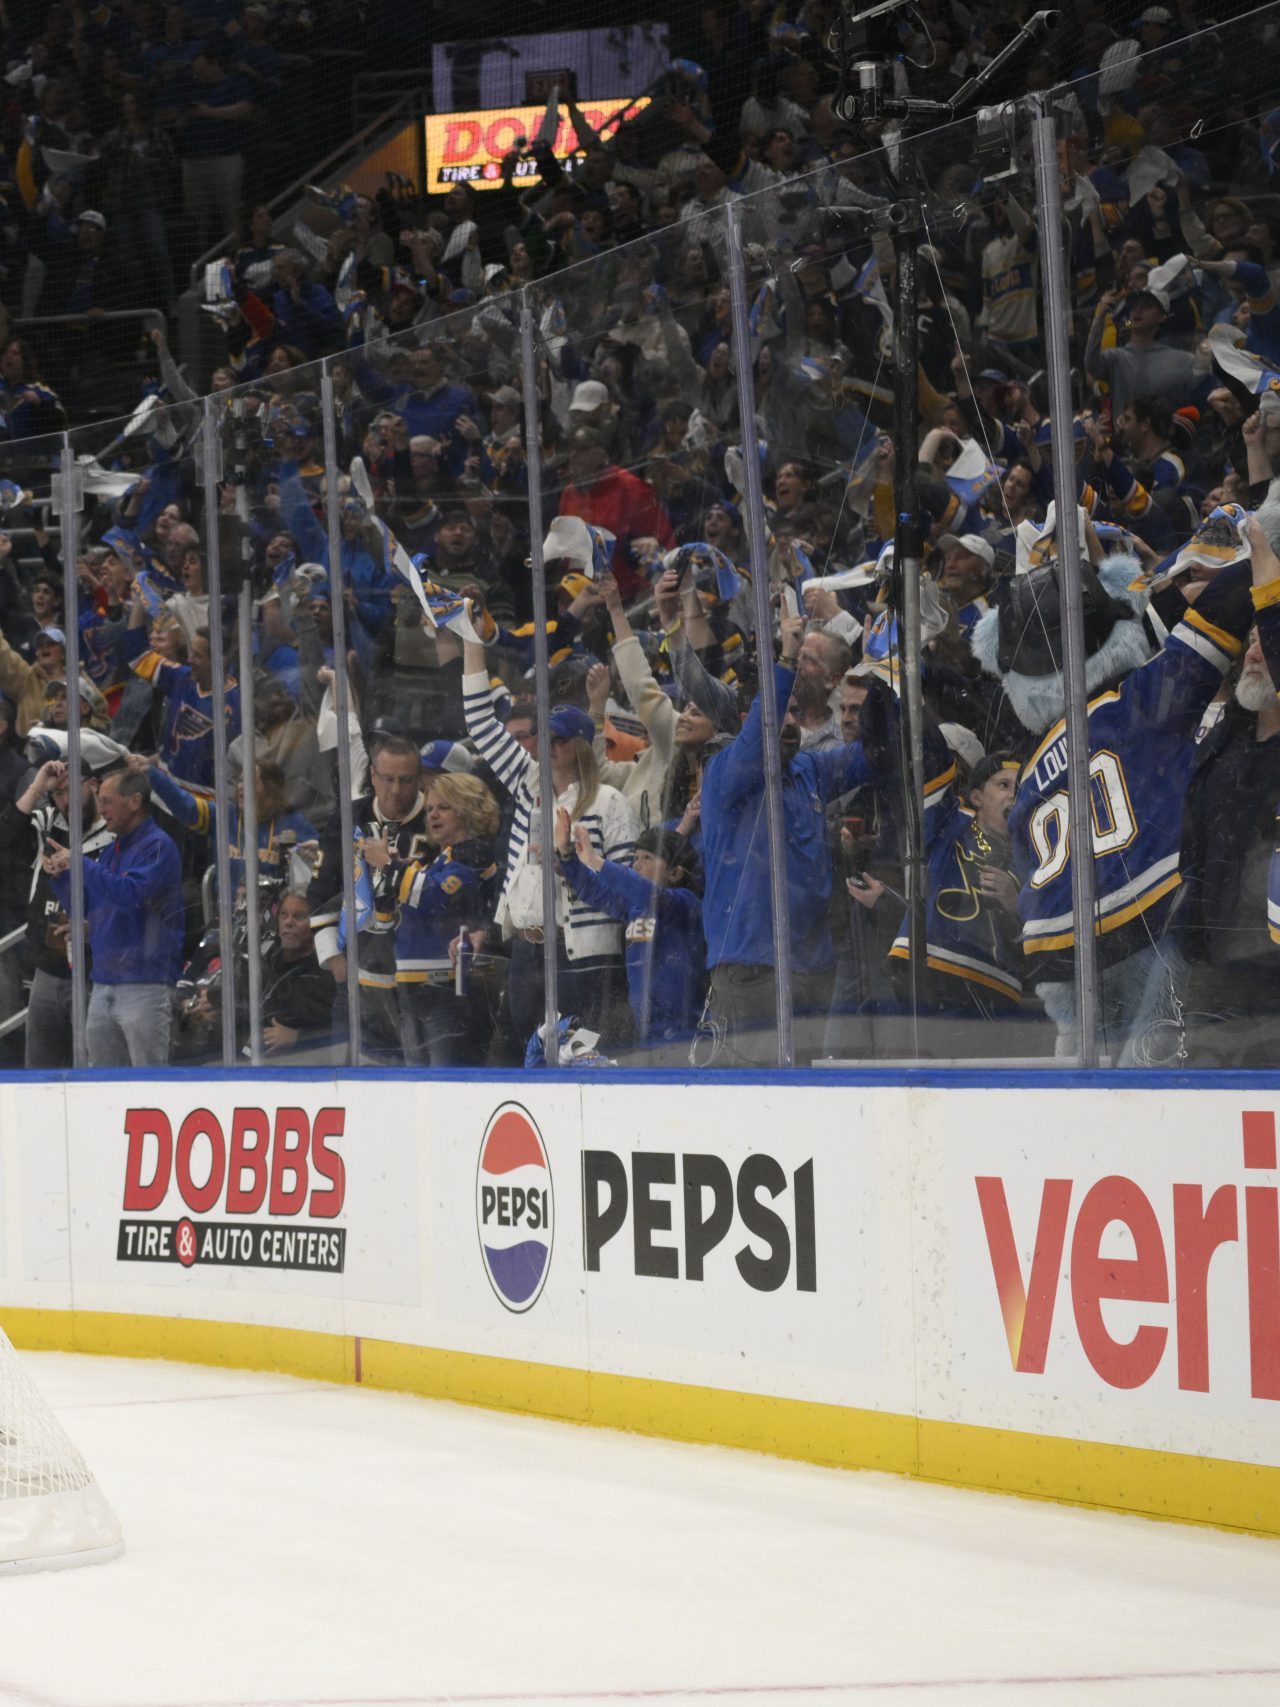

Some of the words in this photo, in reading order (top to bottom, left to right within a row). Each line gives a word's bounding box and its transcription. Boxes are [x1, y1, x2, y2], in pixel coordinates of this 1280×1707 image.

[1034, 737, 1069, 792] LOU
[122, 1106, 346, 1219] DOBBS
[124, 1225, 172, 1257] TIRE
[178, 1225, 193, 1256] &
[201, 1228, 253, 1261] AUTO
[260, 1230, 339, 1266] CENTERS
[481, 1185, 549, 1230] PEPSI
[581, 1149, 817, 1293] PEPSI
[974, 1110, 1280, 1402] veri
